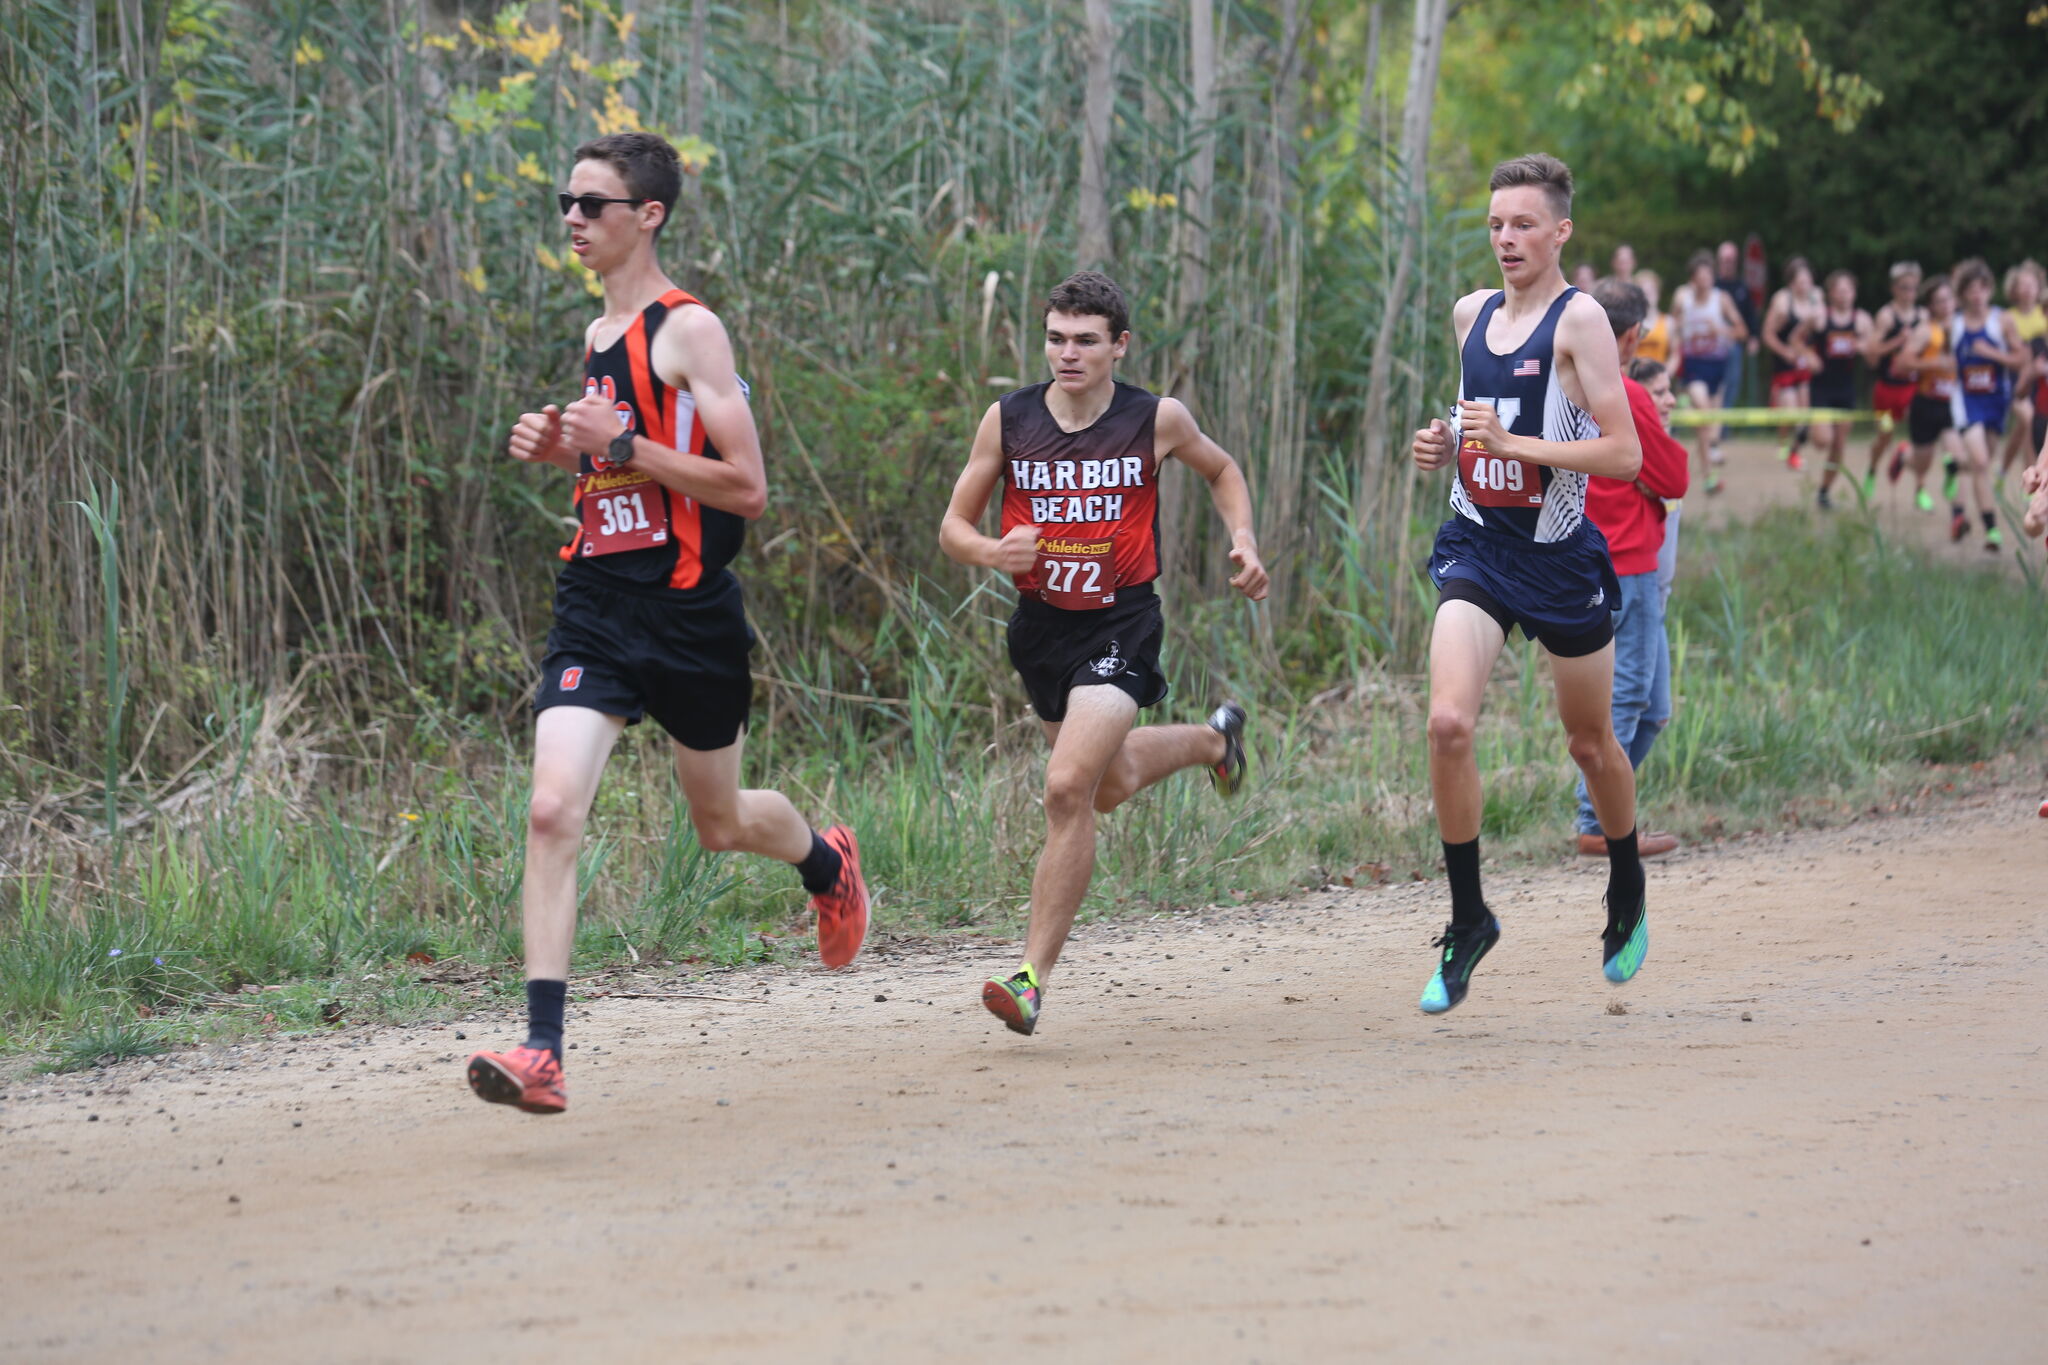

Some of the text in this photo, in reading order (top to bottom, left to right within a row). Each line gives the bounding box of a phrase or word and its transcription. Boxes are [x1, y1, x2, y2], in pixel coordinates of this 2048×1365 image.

[1010, 456, 1144, 490] HARBOR
[1472, 458, 1524, 491] 409
[597, 493, 650, 536] 361
[1029, 494, 1123, 523] BEACH
[1045, 560, 1101, 593] 272
